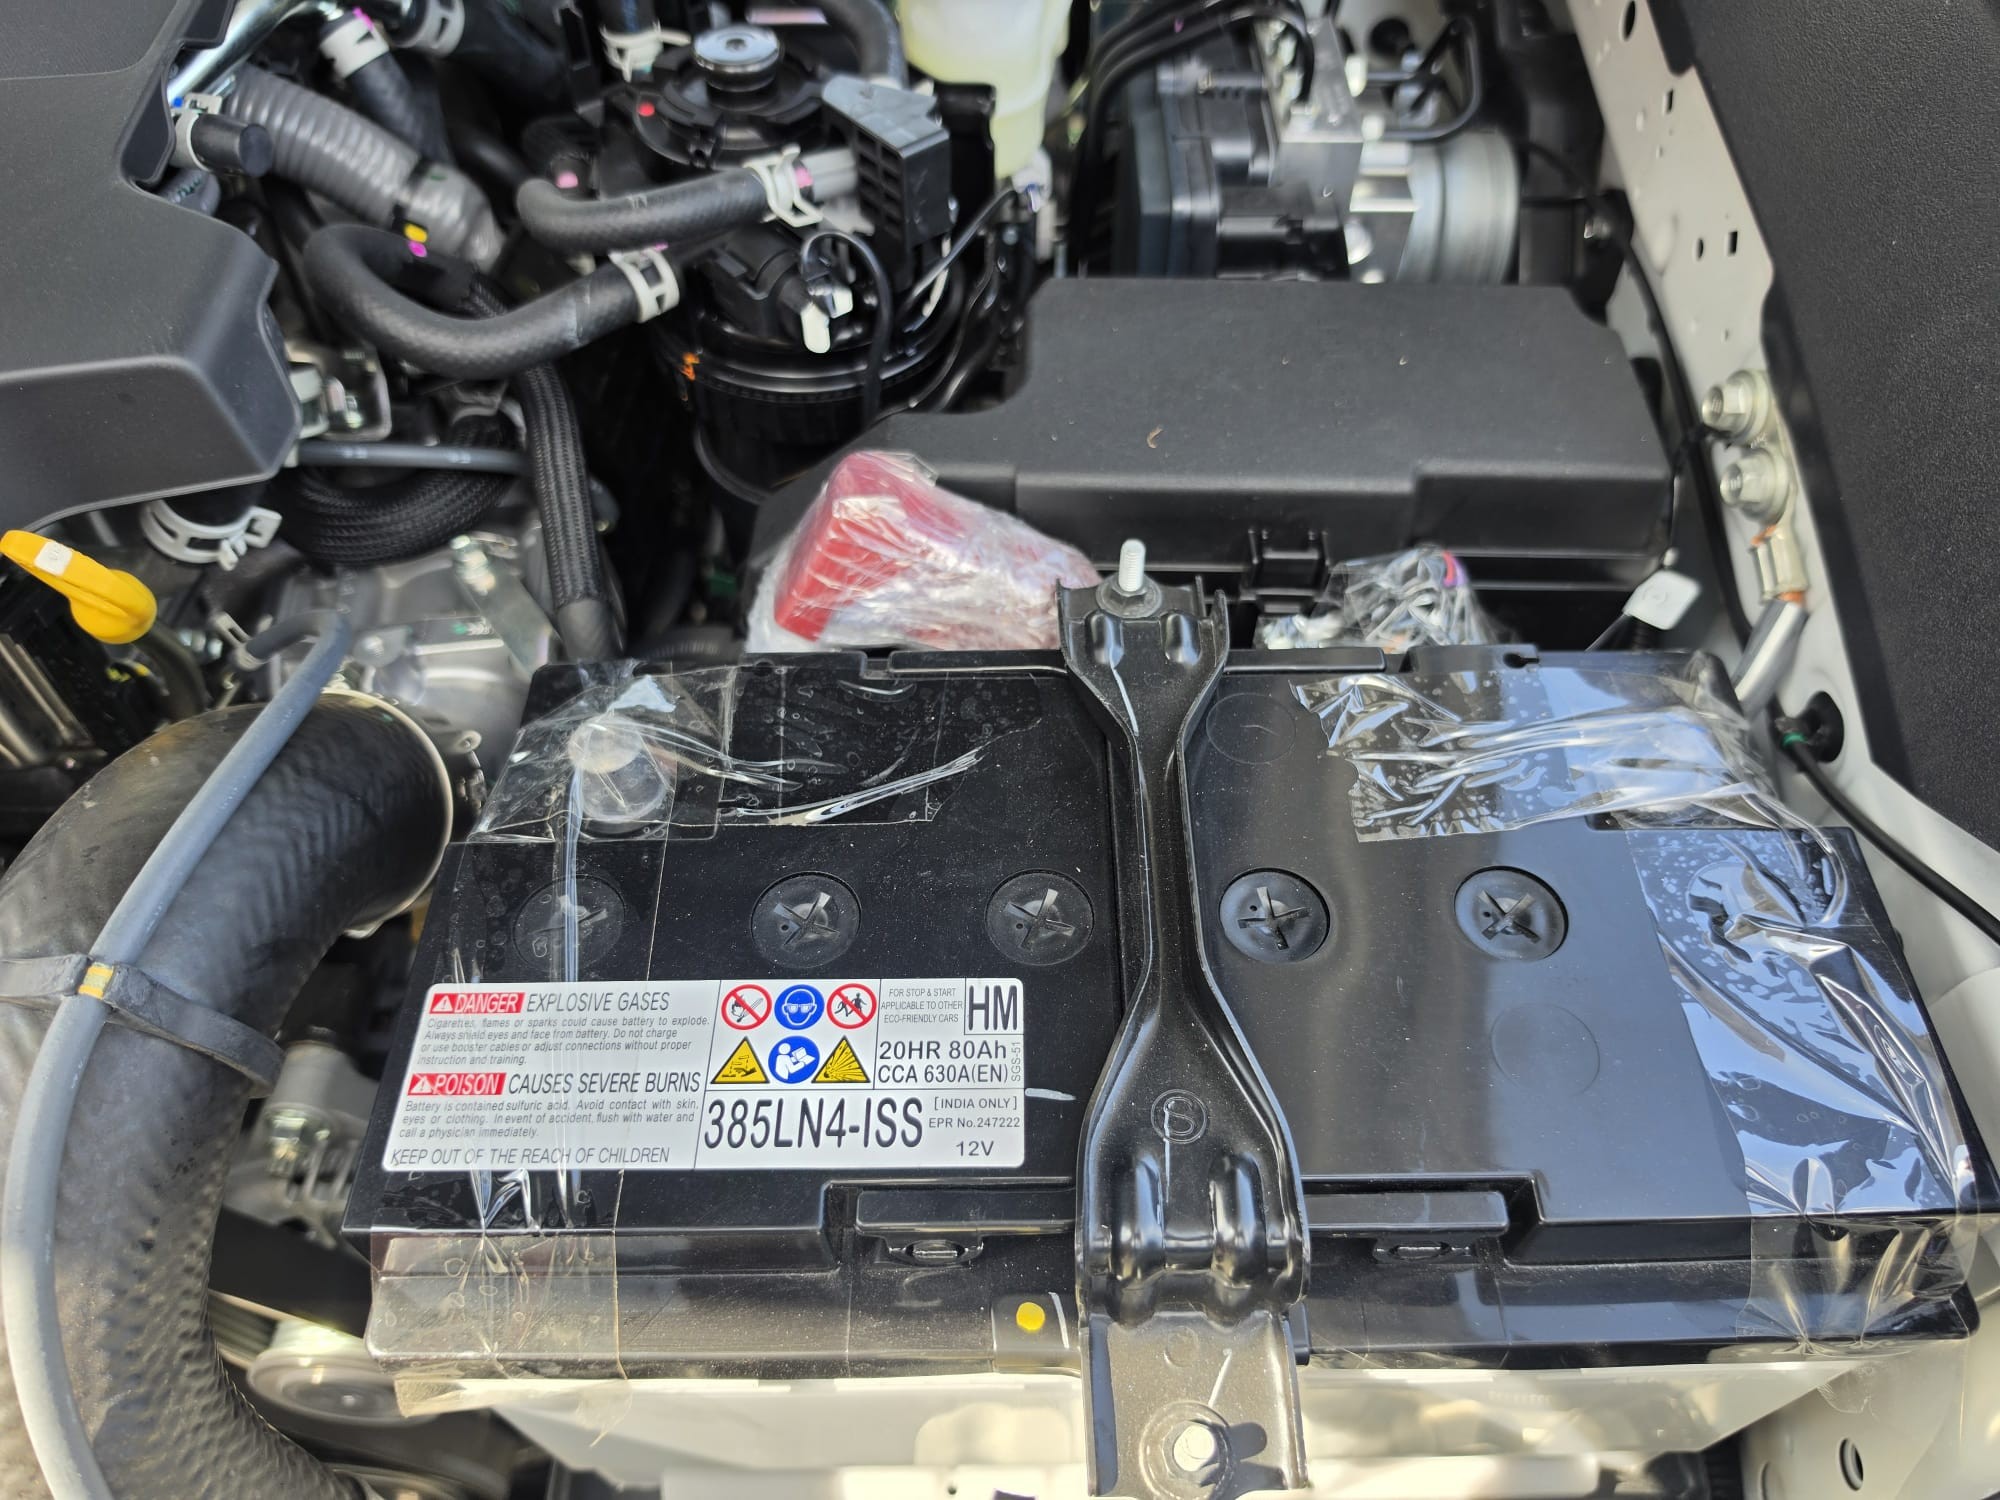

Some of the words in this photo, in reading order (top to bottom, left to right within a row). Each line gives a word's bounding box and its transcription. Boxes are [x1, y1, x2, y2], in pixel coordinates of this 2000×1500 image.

[889, 988, 904, 998] FOR
[905, 988, 925, 997] STOP
[927, 988, 932, 997] &
[933, 988, 956, 997] START
[453, 993, 519, 1013] DANGER
[526, 992, 614, 1012] EXPLOSIVE
[616, 991, 670, 1011] GASES
[881, 1001, 925, 1011] APPLICABLE
[926, 1001, 937, 1010] TO
[938, 1001, 963, 1010] OTHER
[968, 985, 1018, 1031] HM
[482, 1018, 510, 1028] flames
[514, 1019, 524, 1028] or
[528, 1017, 557, 1029] sparks
[561, 1017, 587, 1027] could
[591, 1018, 618, 1027] cause
[622, 1016, 655, 1027] battery
[658, 1016, 668, 1026] to
[671, 1016, 710, 1026] explode.
[883, 1014, 939, 1023] ECO-FRIENDLY
[940, 1014, 959, 1023] CARS
[424, 1030, 456, 1041] Always
[487, 1031, 509, 1041] eyes
[511, 1029, 528, 1039] and
[530, 1029, 550, 1039] face
[552, 1029, 574, 1039] from
[575, 1028, 610, 1040] battery.
[613, 1028, 626, 1038] Do
[628, 1028, 643, 1038] not
[646, 1028, 678, 1039] charge
[420, 1044, 430, 1052] or
[433, 1043, 448, 1052] use
[490, 1042, 519, 1052] cables
[522, 1043, 531, 1052] or
[534, 1041, 563, 1052] adjust
[565, 1040, 622, 1051] connections
[624, 1040, 658, 1050] without
[660, 1041, 692, 1051] proper
[879, 1041, 941, 1060] 20HR
[949, 1040, 1007, 1060] 80Ah
[417, 1055, 467, 1065] instruction
[469, 1055, 487, 1064] and
[490, 1054, 527, 1066] training.
[1011, 1042, 1021, 1081] SGS-51
[878, 1065, 918, 1083] CCA
[924, 1064, 1008, 1084] 630A(EN)
[432, 1073, 499, 1095] POISON
[508, 1073, 573, 1094] CAUSES
[577, 1072, 640, 1093] SEVERE
[645, 1071, 701, 1093] BURNS
[405, 1100, 441, 1112] Battery
[444, 1101, 453, 1111] is
[455, 1101, 503, 1111] contained
[506, 1100, 542, 1111] sulfuric
[576, 1100, 604, 1110] Avoid
[609, 1100, 647, 1110] contact
[652, 1099, 672, 1109] with
[402, 1114, 425, 1125] eyes
[430, 1115, 441, 1124] or
[446, 1113, 488, 1126] clothing.
[494, 1113, 503, 1123] In
[505, 1114, 533, 1124] event
[536, 1113, 547, 1124] of
[596, 1112, 619, 1123] flush
[623, 1112, 642, 1122] with
[646, 1113, 672, 1122] water
[676, 1112, 695, 1122] and
[704, 1097, 923, 1149] 385LN4-ISS
[928, 1118, 954, 1128] EPR
[956, 1117, 1020, 1129] No.247222
[399, 1127, 417, 1138] call
[419, 1129, 425, 1137] a
[428, 1127, 476, 1139] physician
[478, 1127, 539, 1139] immediately.
[956, 1141, 995, 1157] 12V
[391, 1148, 428, 1165] KEEP
[431, 1148, 462, 1164] OUT
[465, 1148, 485, 1164] OF
[490, 1148, 518, 1164] THE
[521, 1147, 571, 1164] REACH
[575, 1147, 595, 1164] OF
[598, 1147, 670, 1163] CHILDREN
